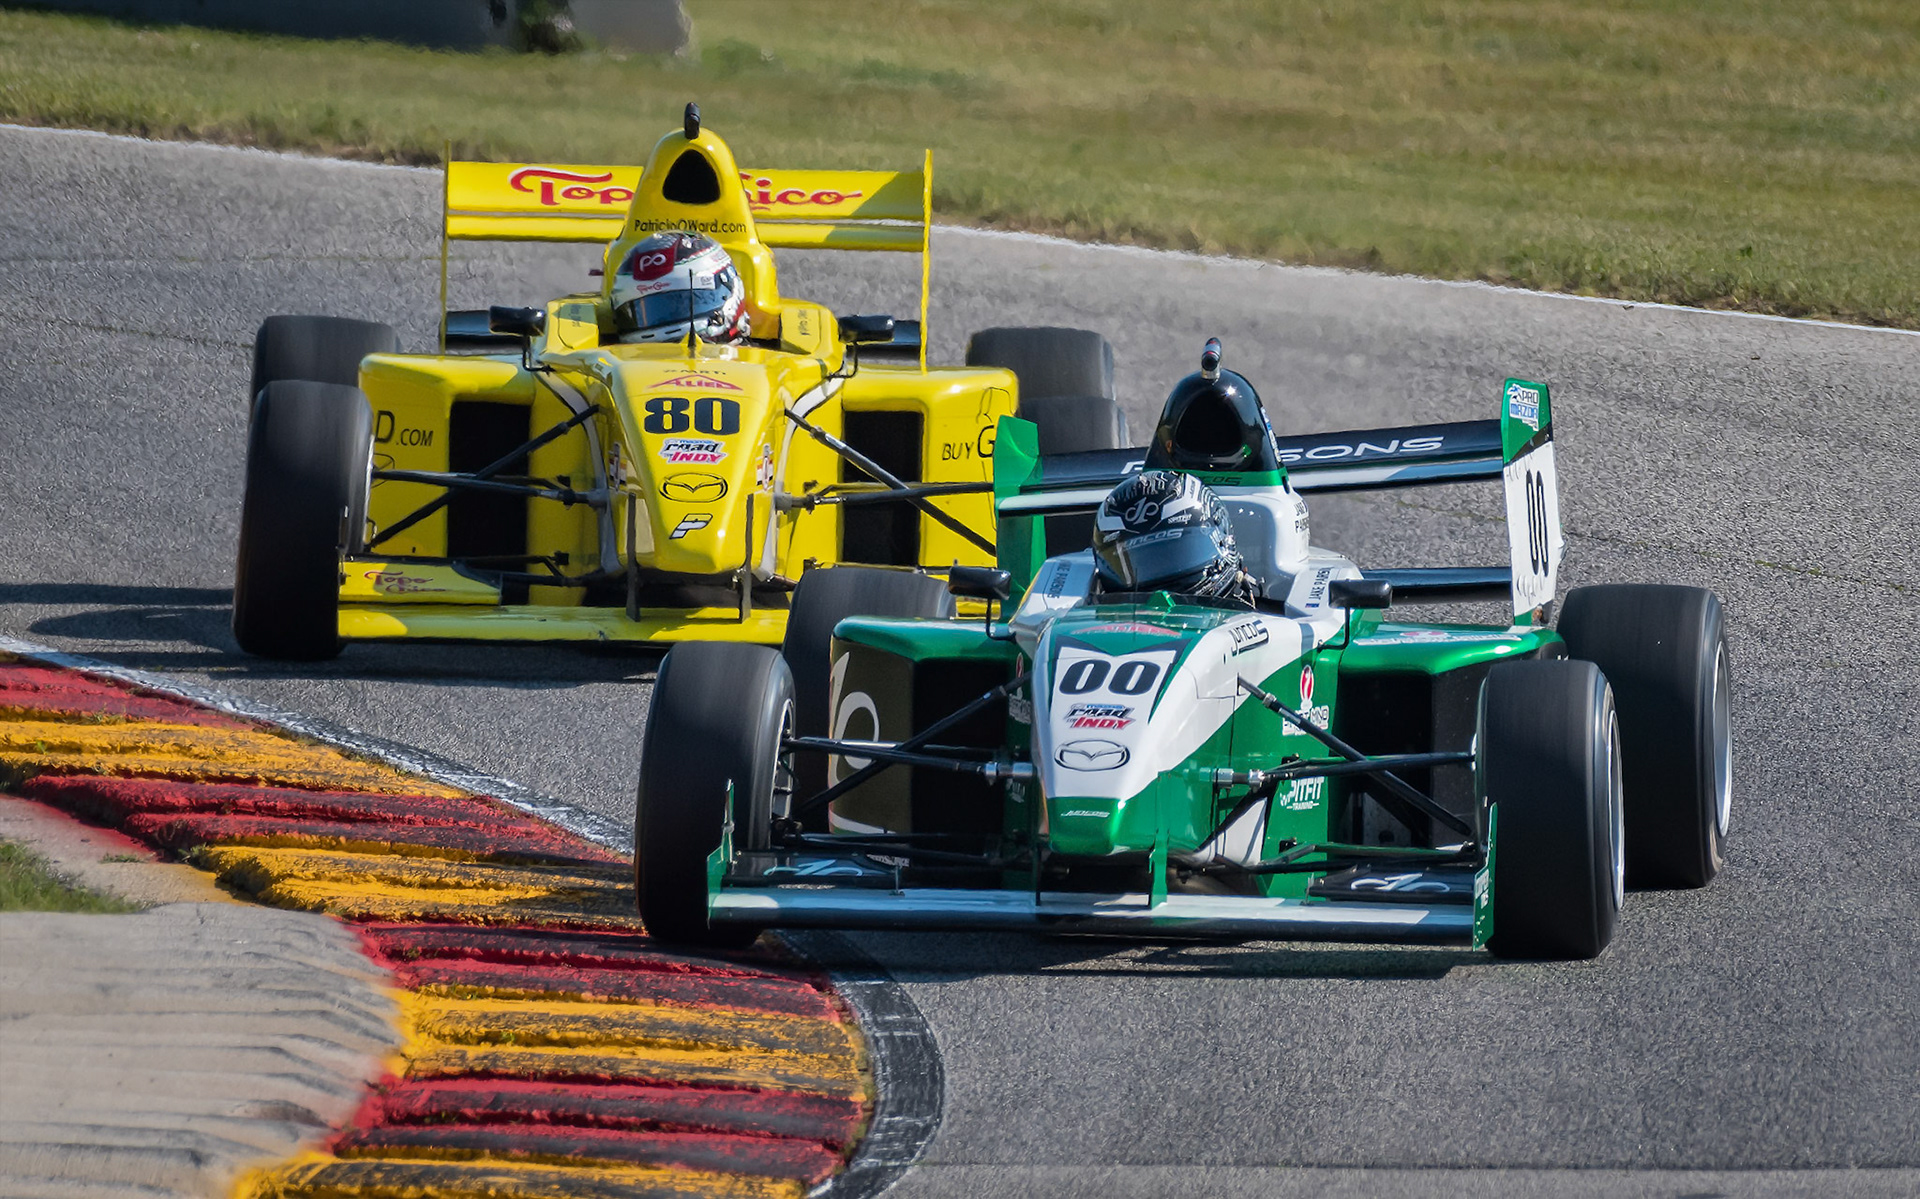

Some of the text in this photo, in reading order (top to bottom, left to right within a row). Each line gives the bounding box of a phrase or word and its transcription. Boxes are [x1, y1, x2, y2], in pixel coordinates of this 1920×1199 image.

[1522, 390, 1539, 404] PRO
[644, 397, 740, 435] 80
[672, 451, 722, 462] INDY
[1526, 469, 1549, 578] 00
[364, 571, 433, 585] Topo
[1059, 659, 1161, 695] 00
[1074, 717, 1131, 729] INDY
